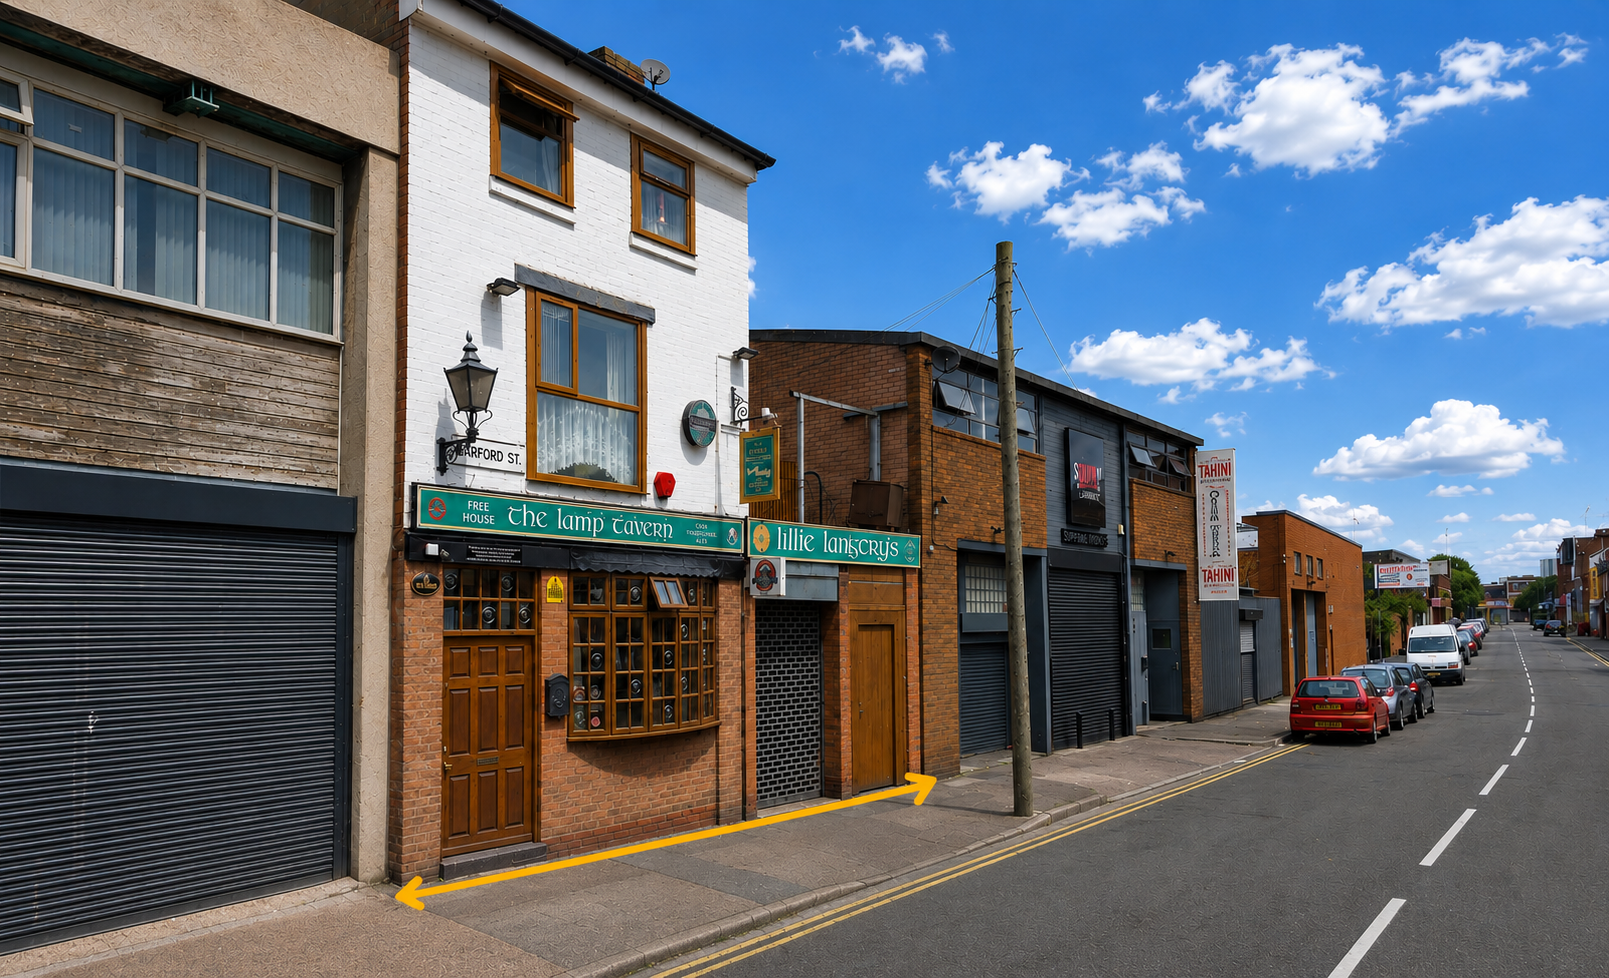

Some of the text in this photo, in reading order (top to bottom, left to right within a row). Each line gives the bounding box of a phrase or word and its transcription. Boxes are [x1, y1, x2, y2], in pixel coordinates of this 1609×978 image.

[507, 452, 522, 465] ST.
[1197, 462, 1231, 478] TAHINI
[467, 500, 490, 512] FREE
[462, 512, 495, 525] HOUSE
[507, 503, 548, 528] The
[776, 526, 815, 552] lillie
[1201, 567, 1234, 583] TAHINI
